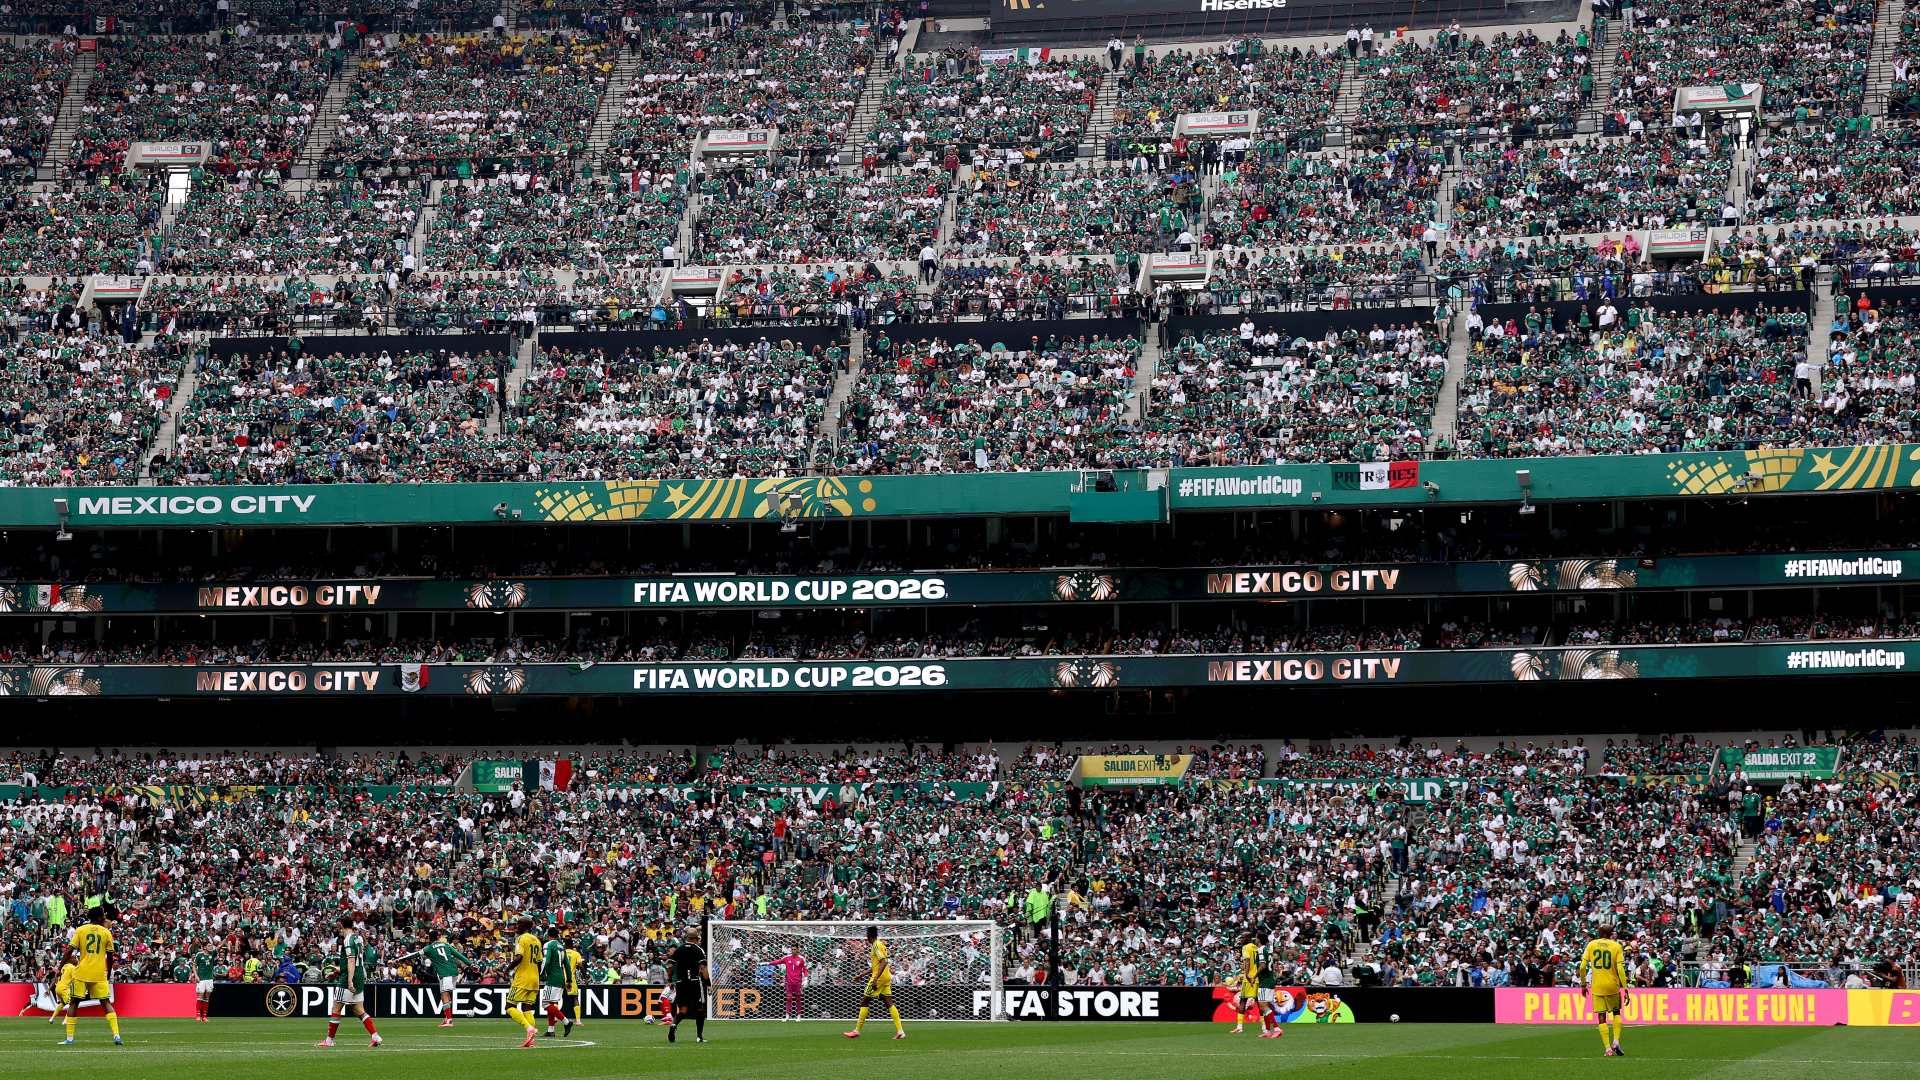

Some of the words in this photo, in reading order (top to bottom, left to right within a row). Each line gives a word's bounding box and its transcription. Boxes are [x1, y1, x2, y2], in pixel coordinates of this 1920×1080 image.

[1201, 0, 1286, 11] Hisense
[1232, 115, 1246, 124] 65
[750, 133, 765, 141] 66
[184, 146, 199, 154] 67
[1692, 231, 1707, 241] 22
[1179, 476, 1302, 497] #FIFAWorldCup
[78, 496, 222, 515] MEXICO
[230, 495, 316, 514] CITY
[1784, 557, 1902, 577] #FIFAWorldCup
[633, 582, 690, 602] FIFA
[694, 581, 790, 602] WORLD
[794, 580, 848, 602] CUP
[852, 578, 947, 600] 2026
[1207, 571, 1323, 593] MEXICO
[1330, 569, 1399, 592] CITY
[198, 586, 309, 607] MEXICO
[315, 585, 381, 606] CITY
[1787, 648, 1905, 669] #FIFAWorldCup
[633, 668, 690, 689] FIFA
[693, 667, 790, 688] WORLD
[794, 666, 848, 688] CUP
[852, 665, 947, 686] 2026
[1208, 658, 1324, 682] MEXICO
[1331, 657, 1401, 680] CITY
[196, 671, 307, 692] MEXICO
[313, 670, 380, 692] CITY
[1104, 760, 1136, 772] SALIDA
[1137, 760, 1157, 771] EXIT
[1159, 760, 1171, 771] 23
[1745, 753, 1780, 766] SALIDA
[1780, 752, 1802, 765] EXIT
[1803, 752, 1816, 765] 22
[494, 767, 523, 779] SALID
[86, 934, 101, 954] 21
[436, 947, 448, 961] 4
[1593, 949, 1612, 970] 20
[302, 986, 346, 1016] PI
[390, 987, 563, 1015] INVEST
[621, 988, 762, 1016] BEER
[1058, 990, 1159, 1017] STORE
[1524, 992, 1593, 1021] PLAY.
[1607, 992, 1679, 1021] OVE.
[1687, 993, 1750, 1022] HAVE
[1757, 993, 1816, 1022] FUN!
